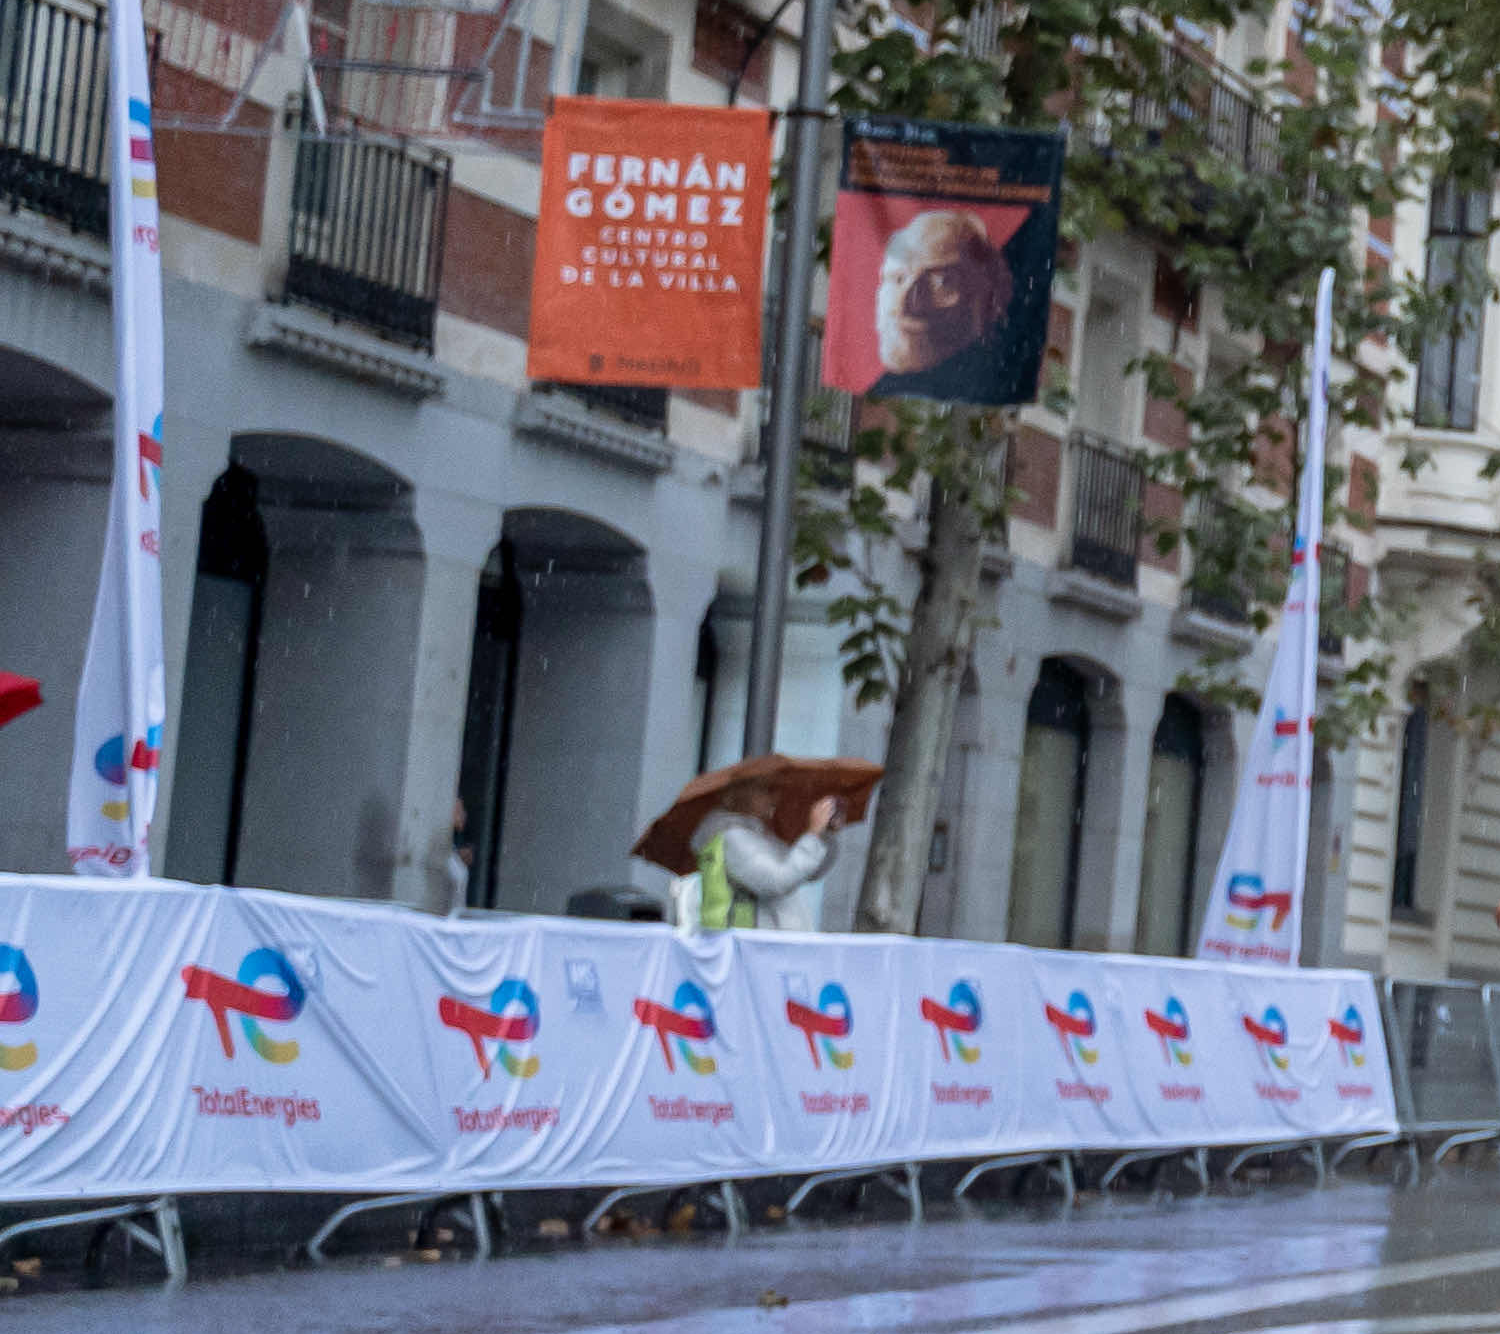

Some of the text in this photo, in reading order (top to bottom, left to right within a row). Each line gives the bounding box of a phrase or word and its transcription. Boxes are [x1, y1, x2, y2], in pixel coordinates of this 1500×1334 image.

[567, 152, 746, 192] FERNÁN
[565, 183, 744, 227] GÓMEZ
[600, 225, 708, 249] CENTRO
[581, 245, 720, 271] CULTURAL
[560, 265, 738, 293] DE LA VILLA
